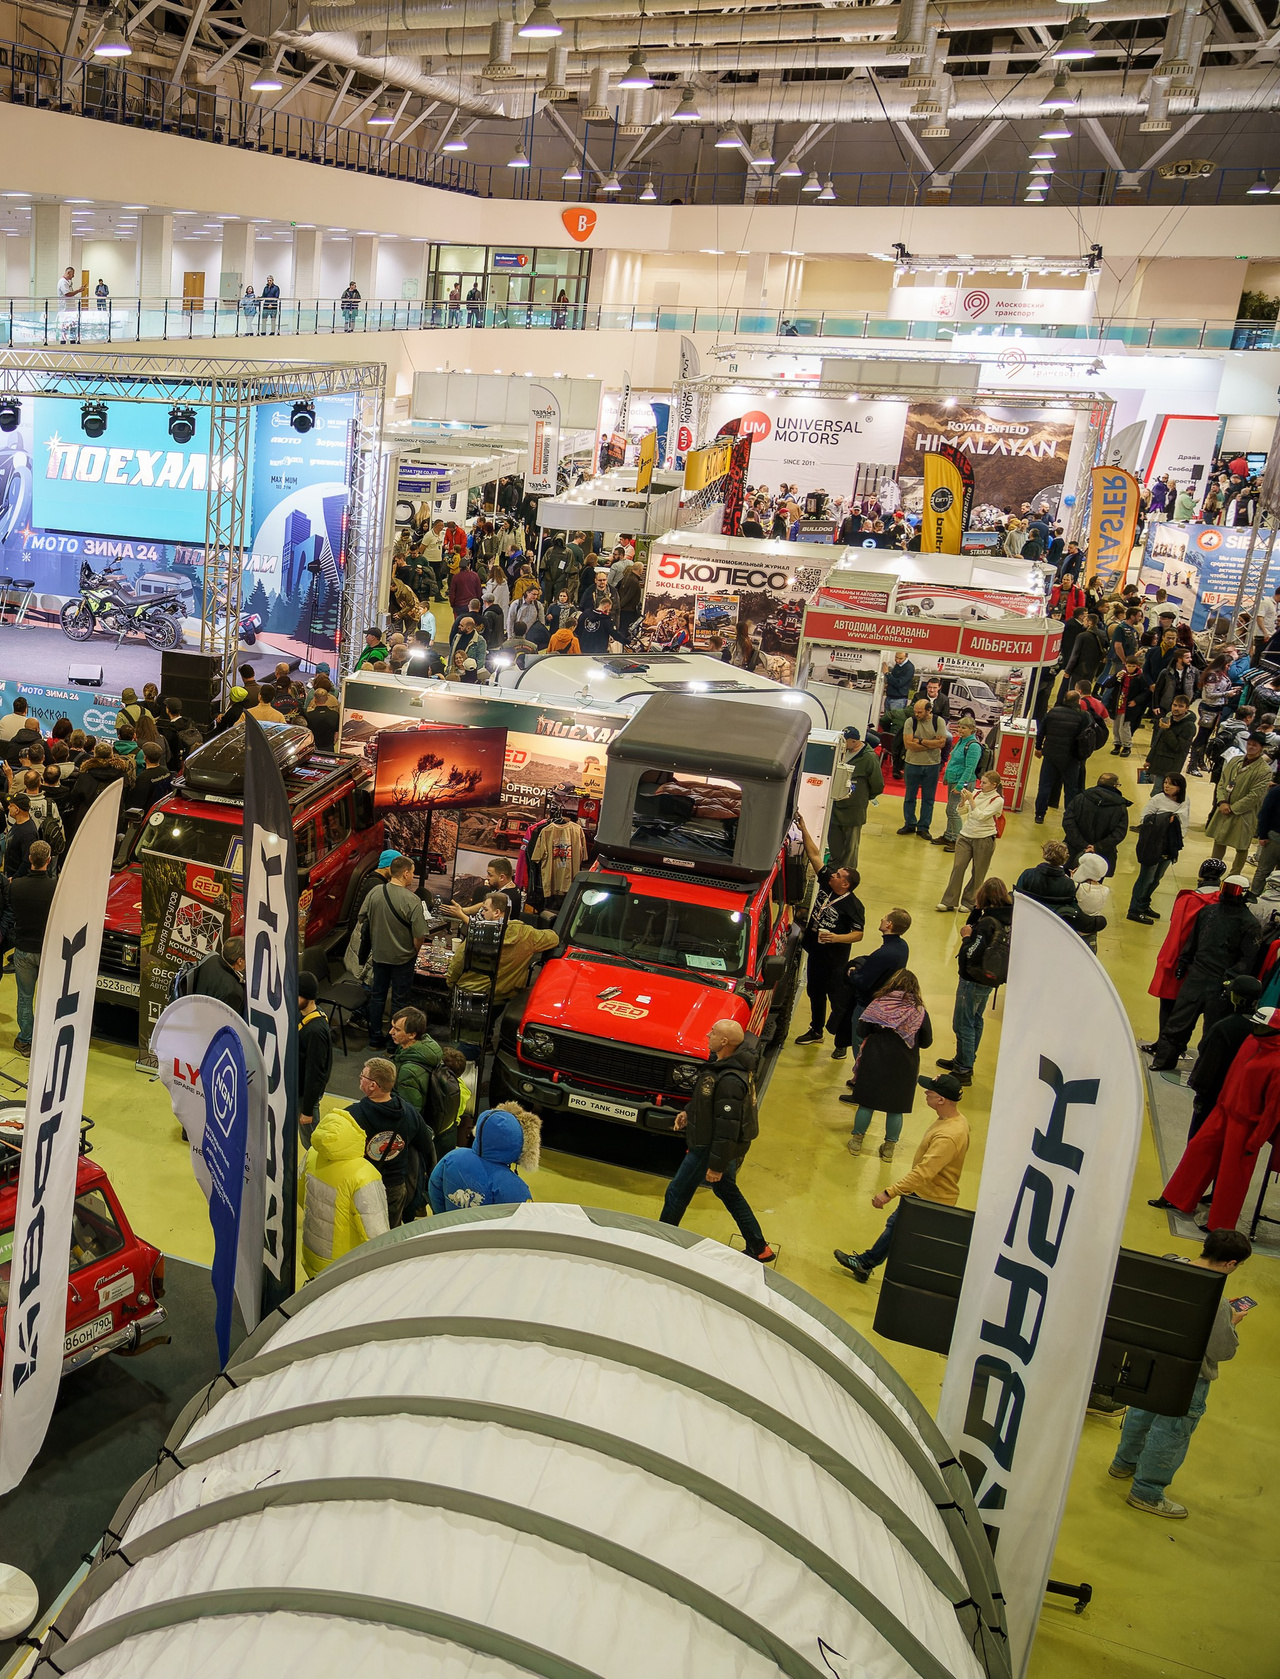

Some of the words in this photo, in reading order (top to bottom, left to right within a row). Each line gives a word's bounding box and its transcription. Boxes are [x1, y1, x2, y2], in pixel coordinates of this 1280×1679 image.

[995, 301, 1045, 309] Московский
[744, 421, 766, 434] UM
[776, 416, 863, 434] UNIVERSAL
[947, 421, 982, 432] ROYAL
[984, 422, 1029, 435] ENFIELD
[680, 430, 688, 448] UM
[774, 430, 840, 446] MOTORS
[915, 433, 1057, 458] HIMALAYAN
[46, 443, 240, 493] ПОЕХАЛИ
[309, 459, 346, 467] greenwork
[31, 534, 79, 553] МОТО
[83, 540, 134, 560] ЗИМА
[136, 546, 158, 561] 24
[711, 558, 763, 568] АВТОМОБИЛЬНЫЙ
[655, 581, 704, 591] 5KOLESO.RU
[833, 620, 876, 633] АВТОДОМА
[884, 625, 930, 638] КАРАВАНЫ
[847, 632, 913, 644] www.albrehta.ru
[970, 636, 1033, 654] АЛЬБРЕХТА
[21, 685, 43, 695] МОТО
[45, 688, 68, 700] ЗИМА
[69, 692, 79, 701] 24
[504, 749, 528, 764] ED
[195, 881, 221, 894] RED
[157, 929, 169, 955] ЗЕМЛЯ
[164, 891, 179, 929] ВОГУЛОВ
[169, 940, 204, 960] КОЧУЮЩ
[601, 1003, 645, 1016] RED
[173, 1079, 195, 1095] SPARE
[216, 1072, 234, 1112] NGN
[570, 1097, 587, 1107] PRO
[590, 1102, 611, 1112] TANK
[614, 1107, 636, 1118] SHOP
[63, 1328, 92, 1351] 86ОН
[94, 1317, 111, 1333] 790
